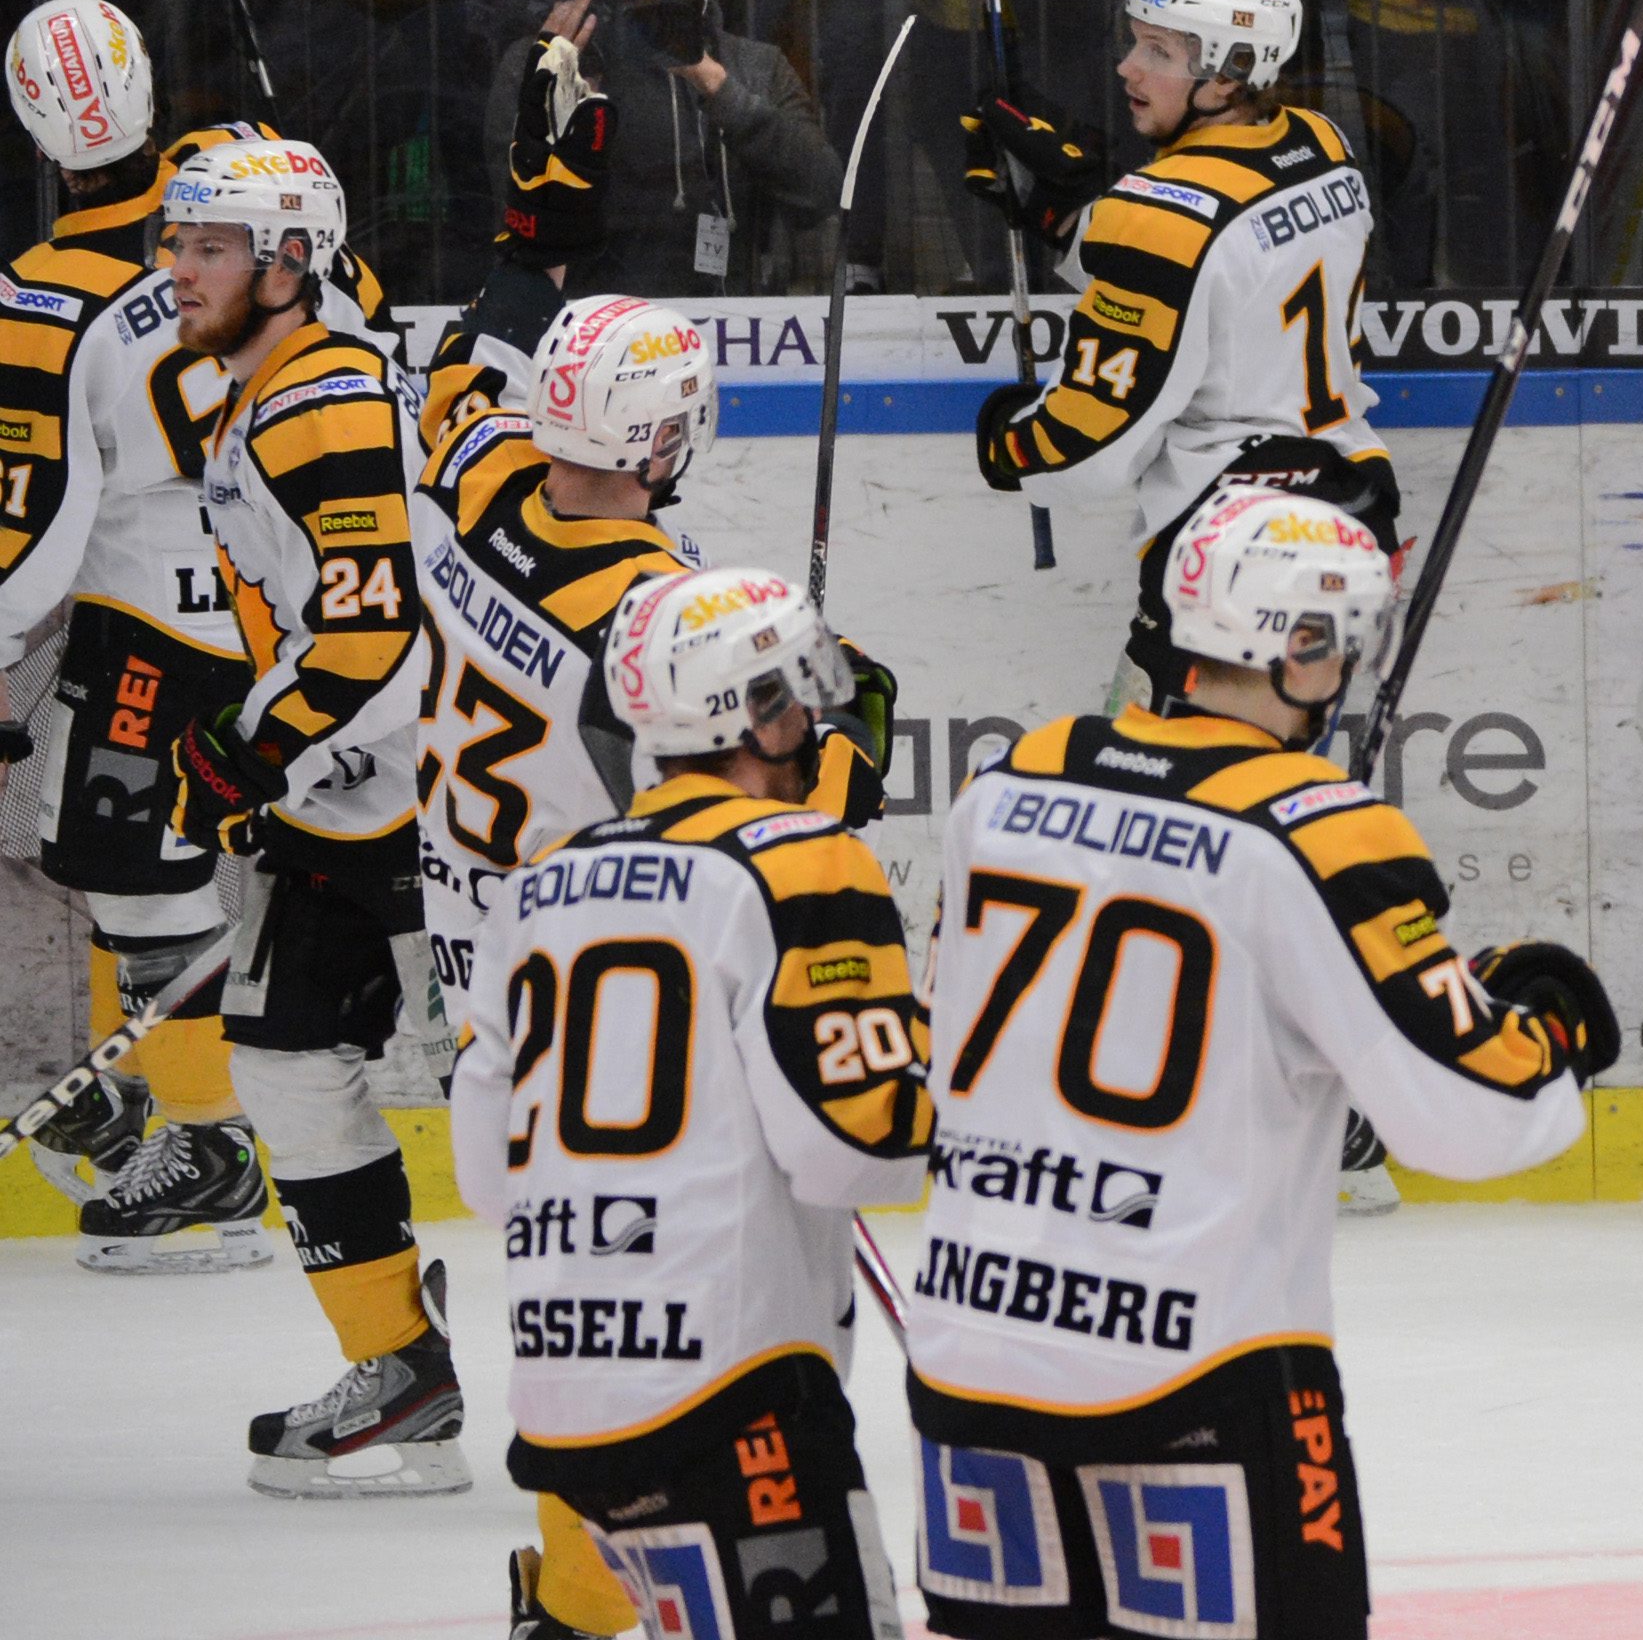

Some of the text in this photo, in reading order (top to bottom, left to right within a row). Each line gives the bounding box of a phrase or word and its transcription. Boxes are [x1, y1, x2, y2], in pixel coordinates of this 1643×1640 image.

[1261, 44, 1281, 65] 14
[78, 96, 113, 148] ICA
[231, 150, 324, 180] skebo
[1270, 144, 1314, 171] Reebok
[316, 229, 335, 249] 24
[628, 326, 702, 365] skebo
[1282, 258, 1366, 436] 1
[614, 368, 658, 382] CCM
[1070, 337, 1137, 400] 14
[547, 361, 588, 421] ICA
[625, 422, 653, 444] 23
[320, 512, 377, 531] Reebok
[488, 527, 537, 578] Reebok
[321, 556, 403, 620] 24
[432, 543, 567, 690] BOLIDEN
[1256, 609, 1288, 634] 70
[706, 688, 740, 718] 20
[1095, 744, 1174, 780] Reebok
[1000, 791, 1231, 876] BOLIDEN
[948, 866, 1221, 1135] 70
[814, 1007, 913, 1085] 20
